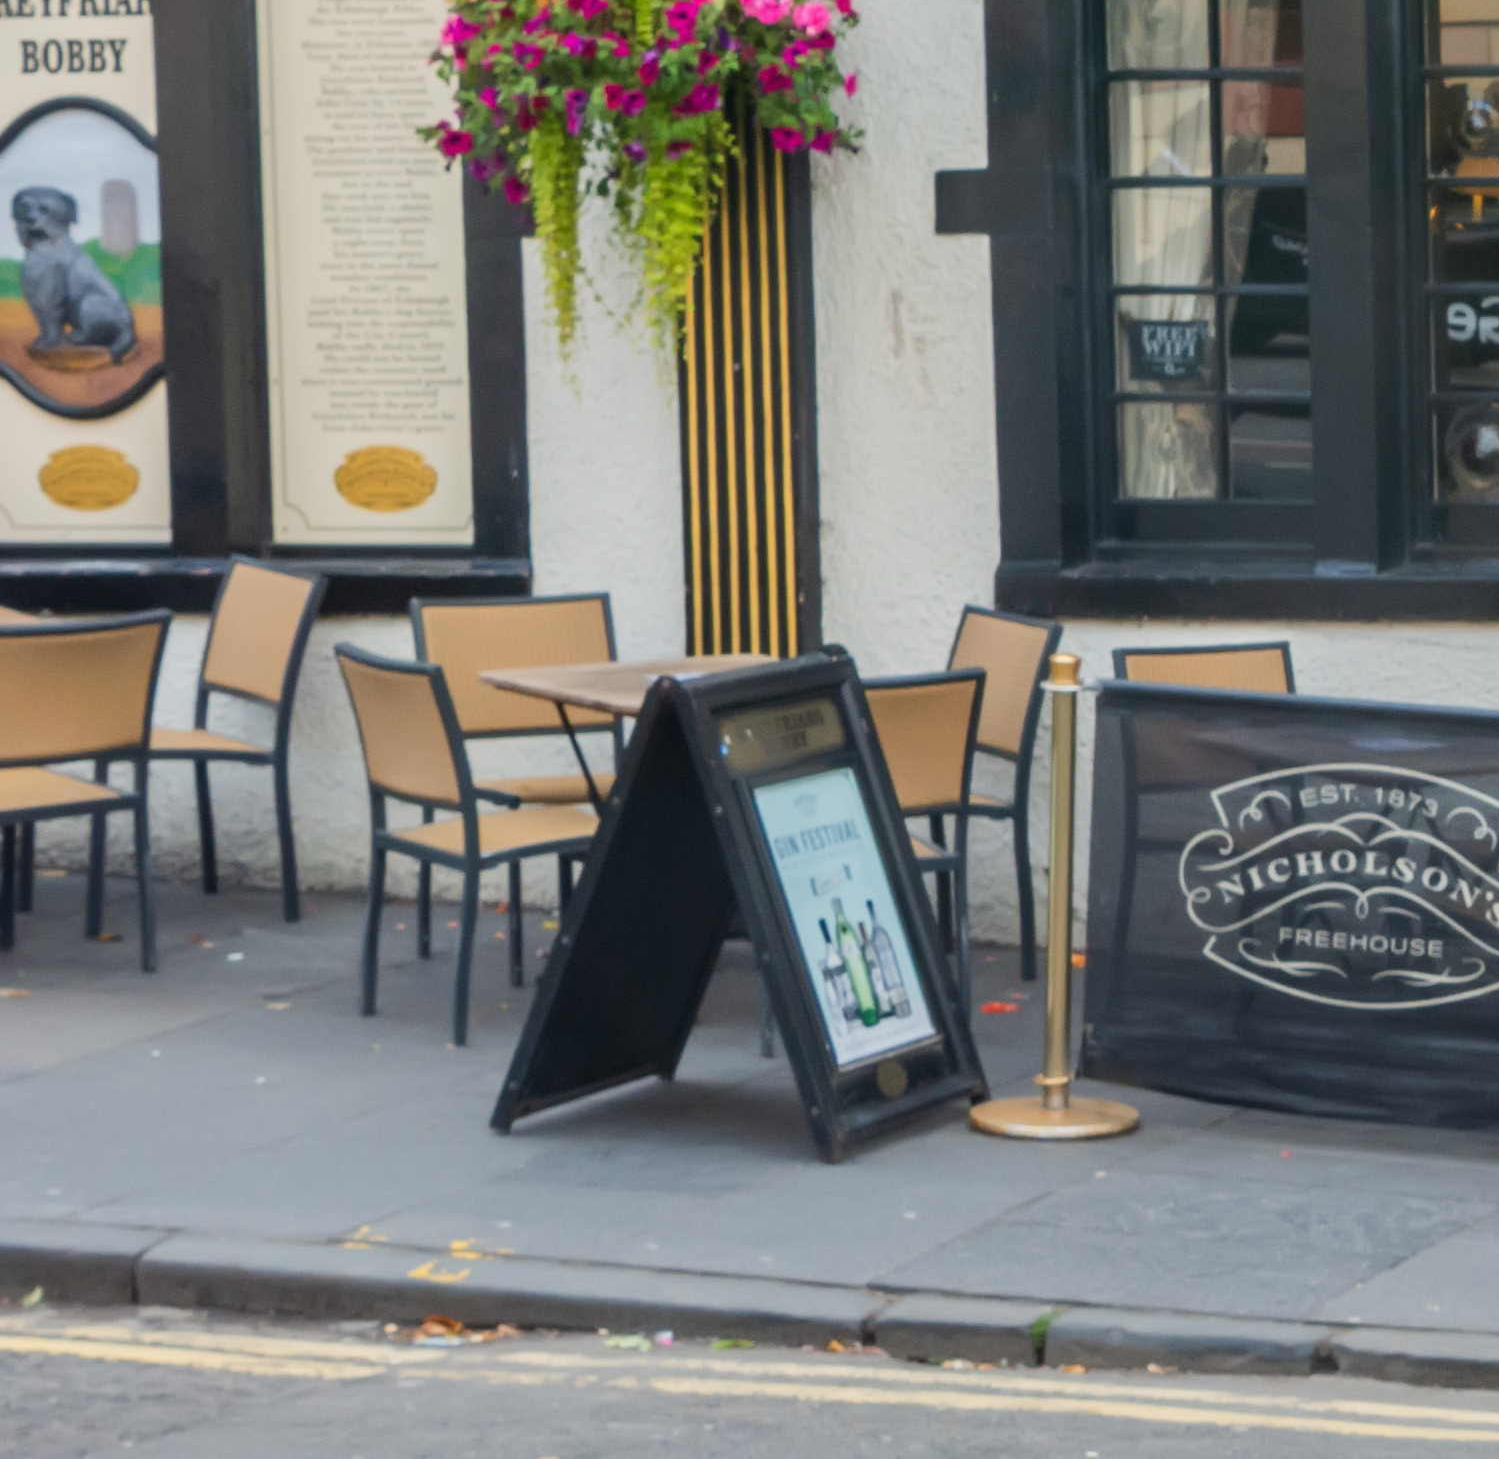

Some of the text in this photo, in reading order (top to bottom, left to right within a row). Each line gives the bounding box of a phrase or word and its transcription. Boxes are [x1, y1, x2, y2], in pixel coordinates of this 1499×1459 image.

[20, 39, 127, 74] BOBBY
[1374, 787, 1439, 818] 1873
[800, 820, 861, 851] FESTIVAL
[1278, 926, 1443, 959] FREEHOUSE
